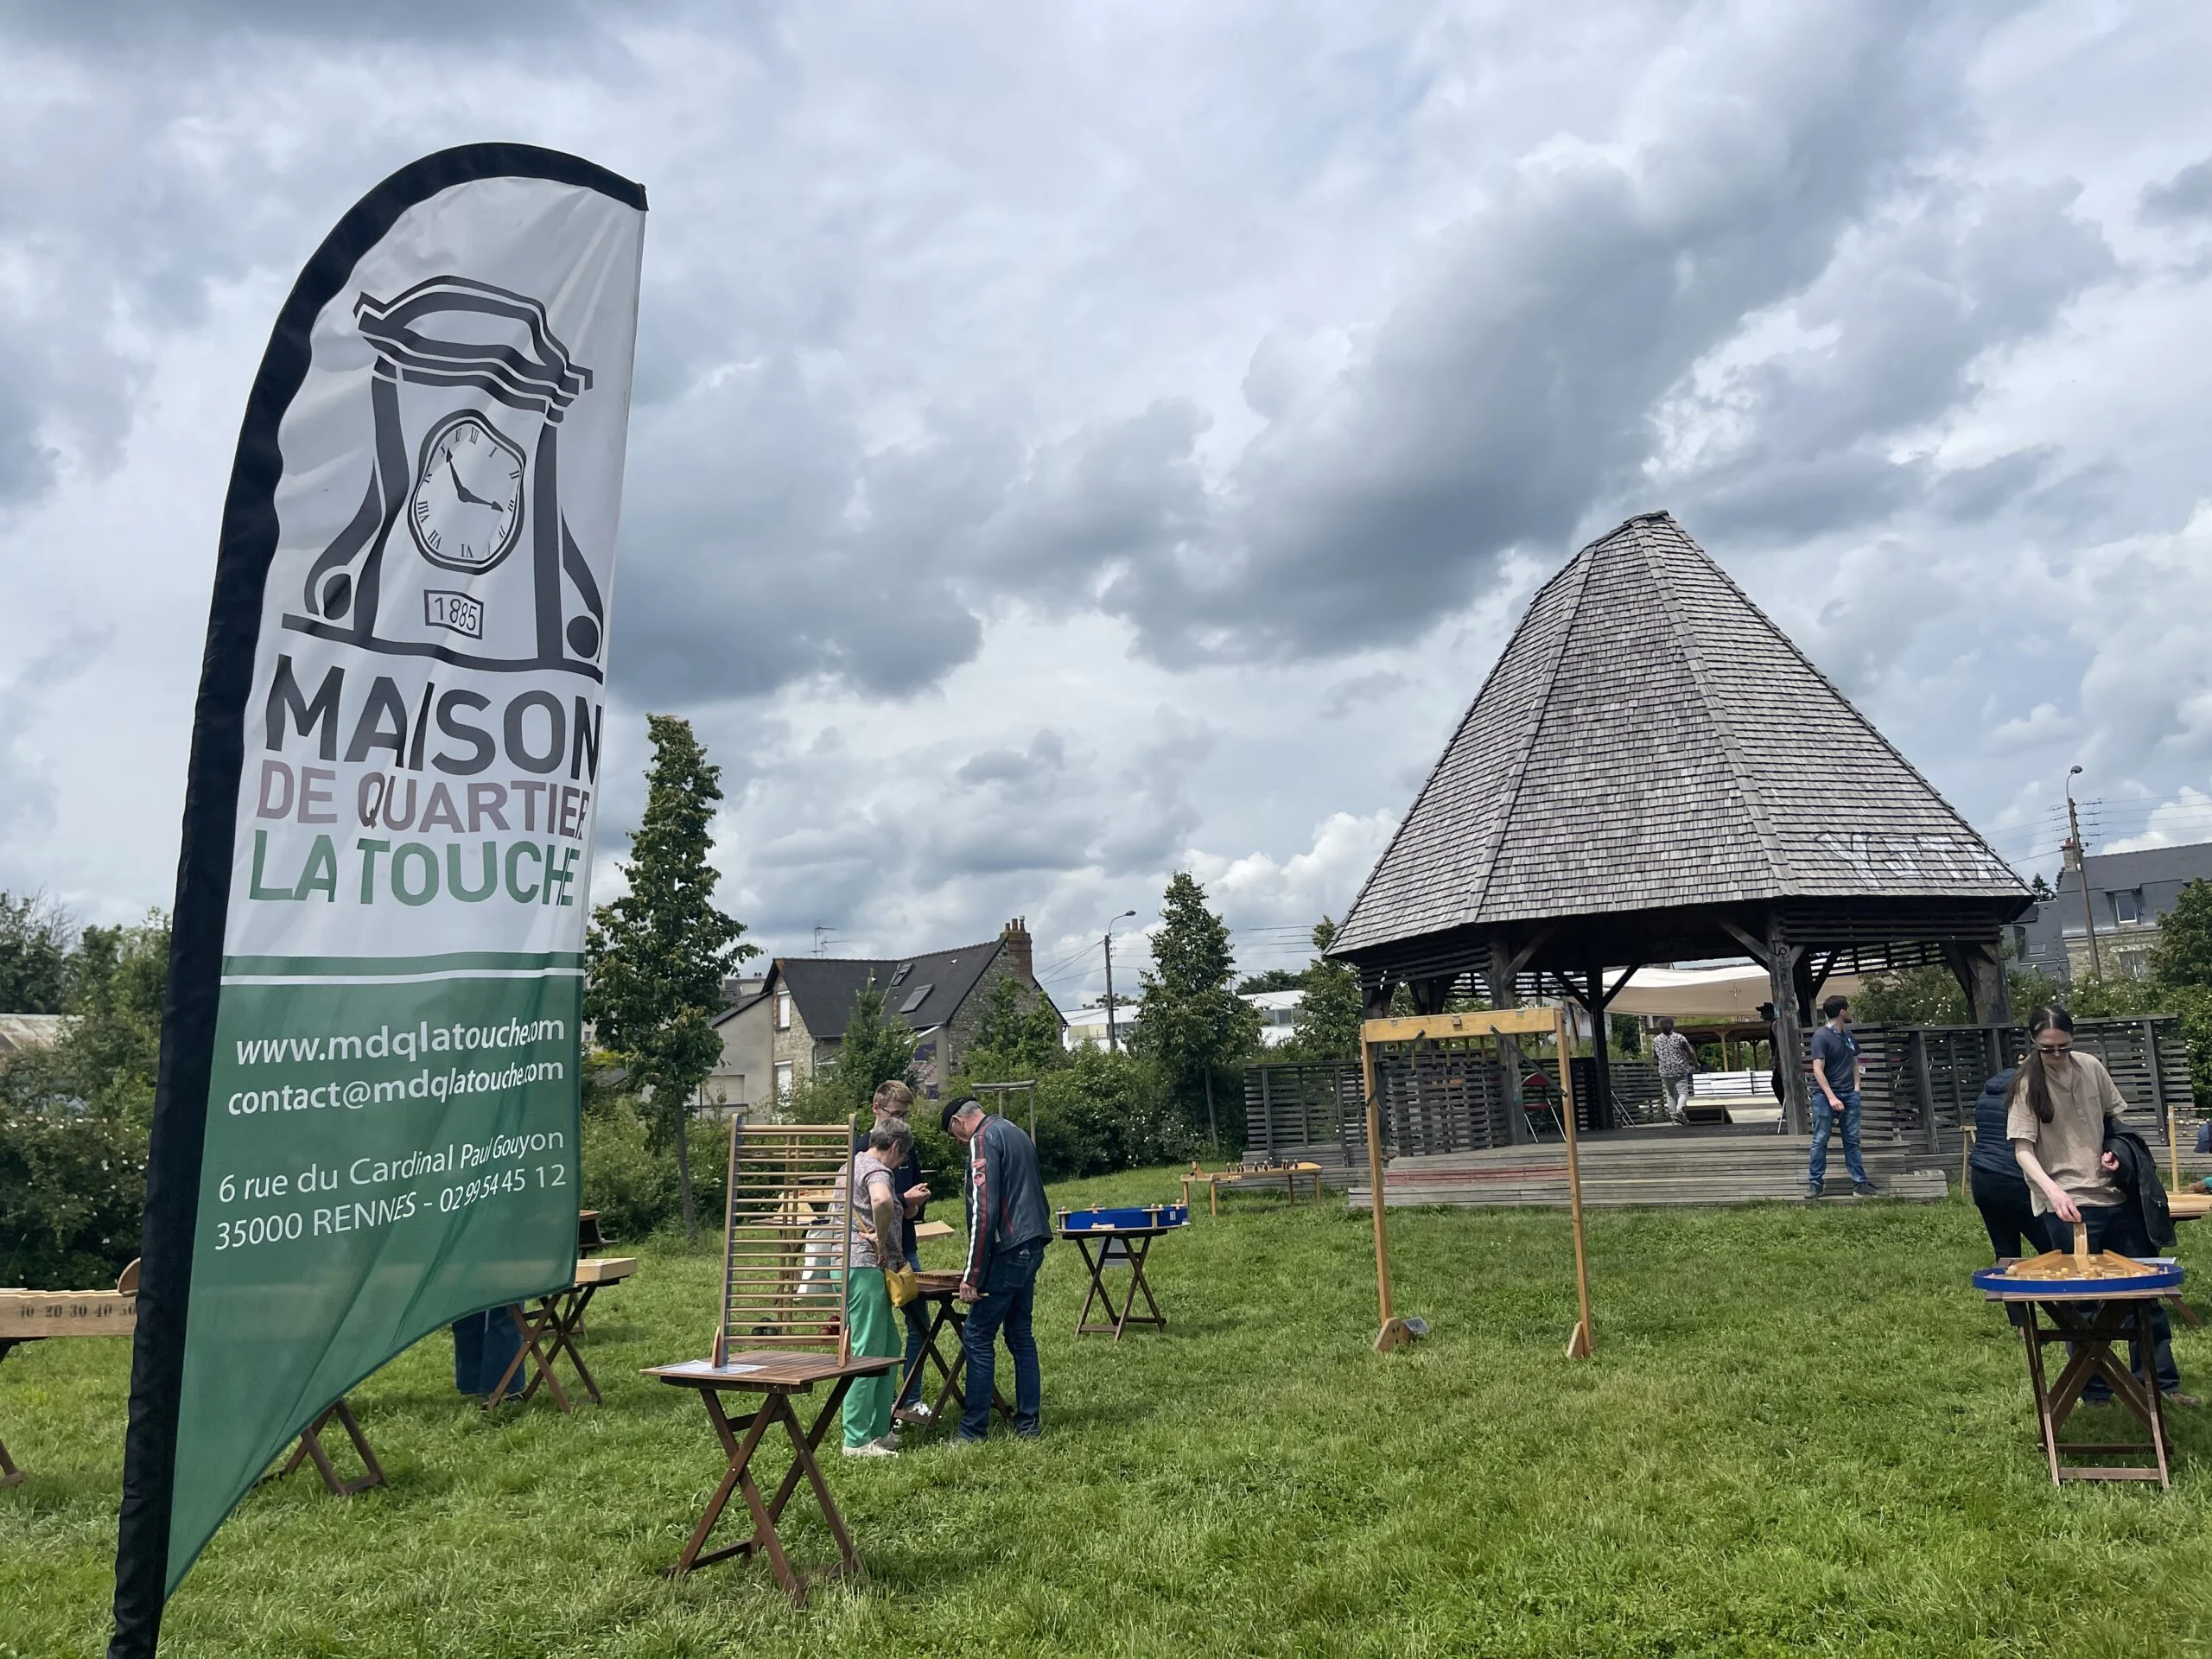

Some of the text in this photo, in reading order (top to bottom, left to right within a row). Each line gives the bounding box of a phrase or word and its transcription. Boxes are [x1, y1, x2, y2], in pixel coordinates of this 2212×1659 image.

[434, 596, 478, 632] 1885
[265, 653, 602, 785] MAISON
[257, 759, 590, 841] DE QUARTIER
[249, 830, 581, 906] LA TOUCHE
[219, 1130, 564, 1203] 6 rue du Cardinal Paul Gouyon
[214, 1212, 303, 1250] 35000
[314, 1192, 417, 1236] RENNES
[535, 1163, 567, 1189] 12
[45, 1304, 63, 1318] 20
[69, 1304, 87, 1318] 30
[93, 1303, 113, 1318] 40
